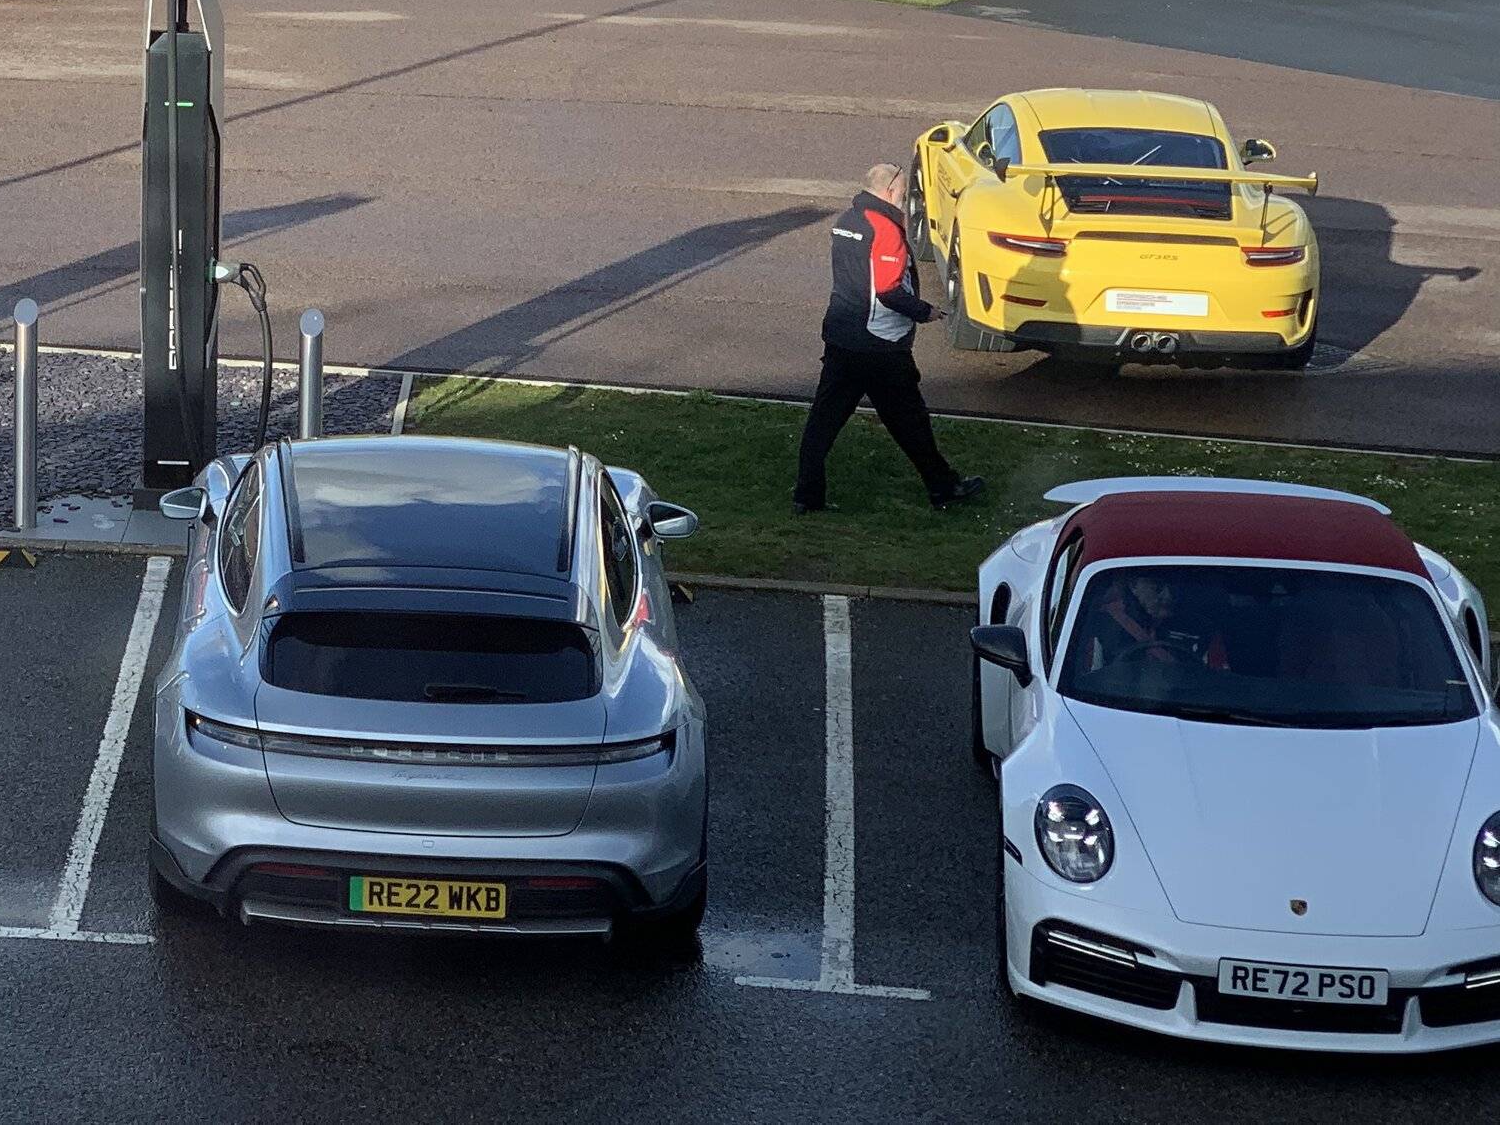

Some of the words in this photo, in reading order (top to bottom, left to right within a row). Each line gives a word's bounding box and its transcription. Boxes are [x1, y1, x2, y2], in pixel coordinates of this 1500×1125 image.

[368, 881, 440, 910] RE22
[448, 885, 500, 912] WKB
[1231, 965, 1309, 997] RE72
[1318, 973, 1375, 1000] PSO
